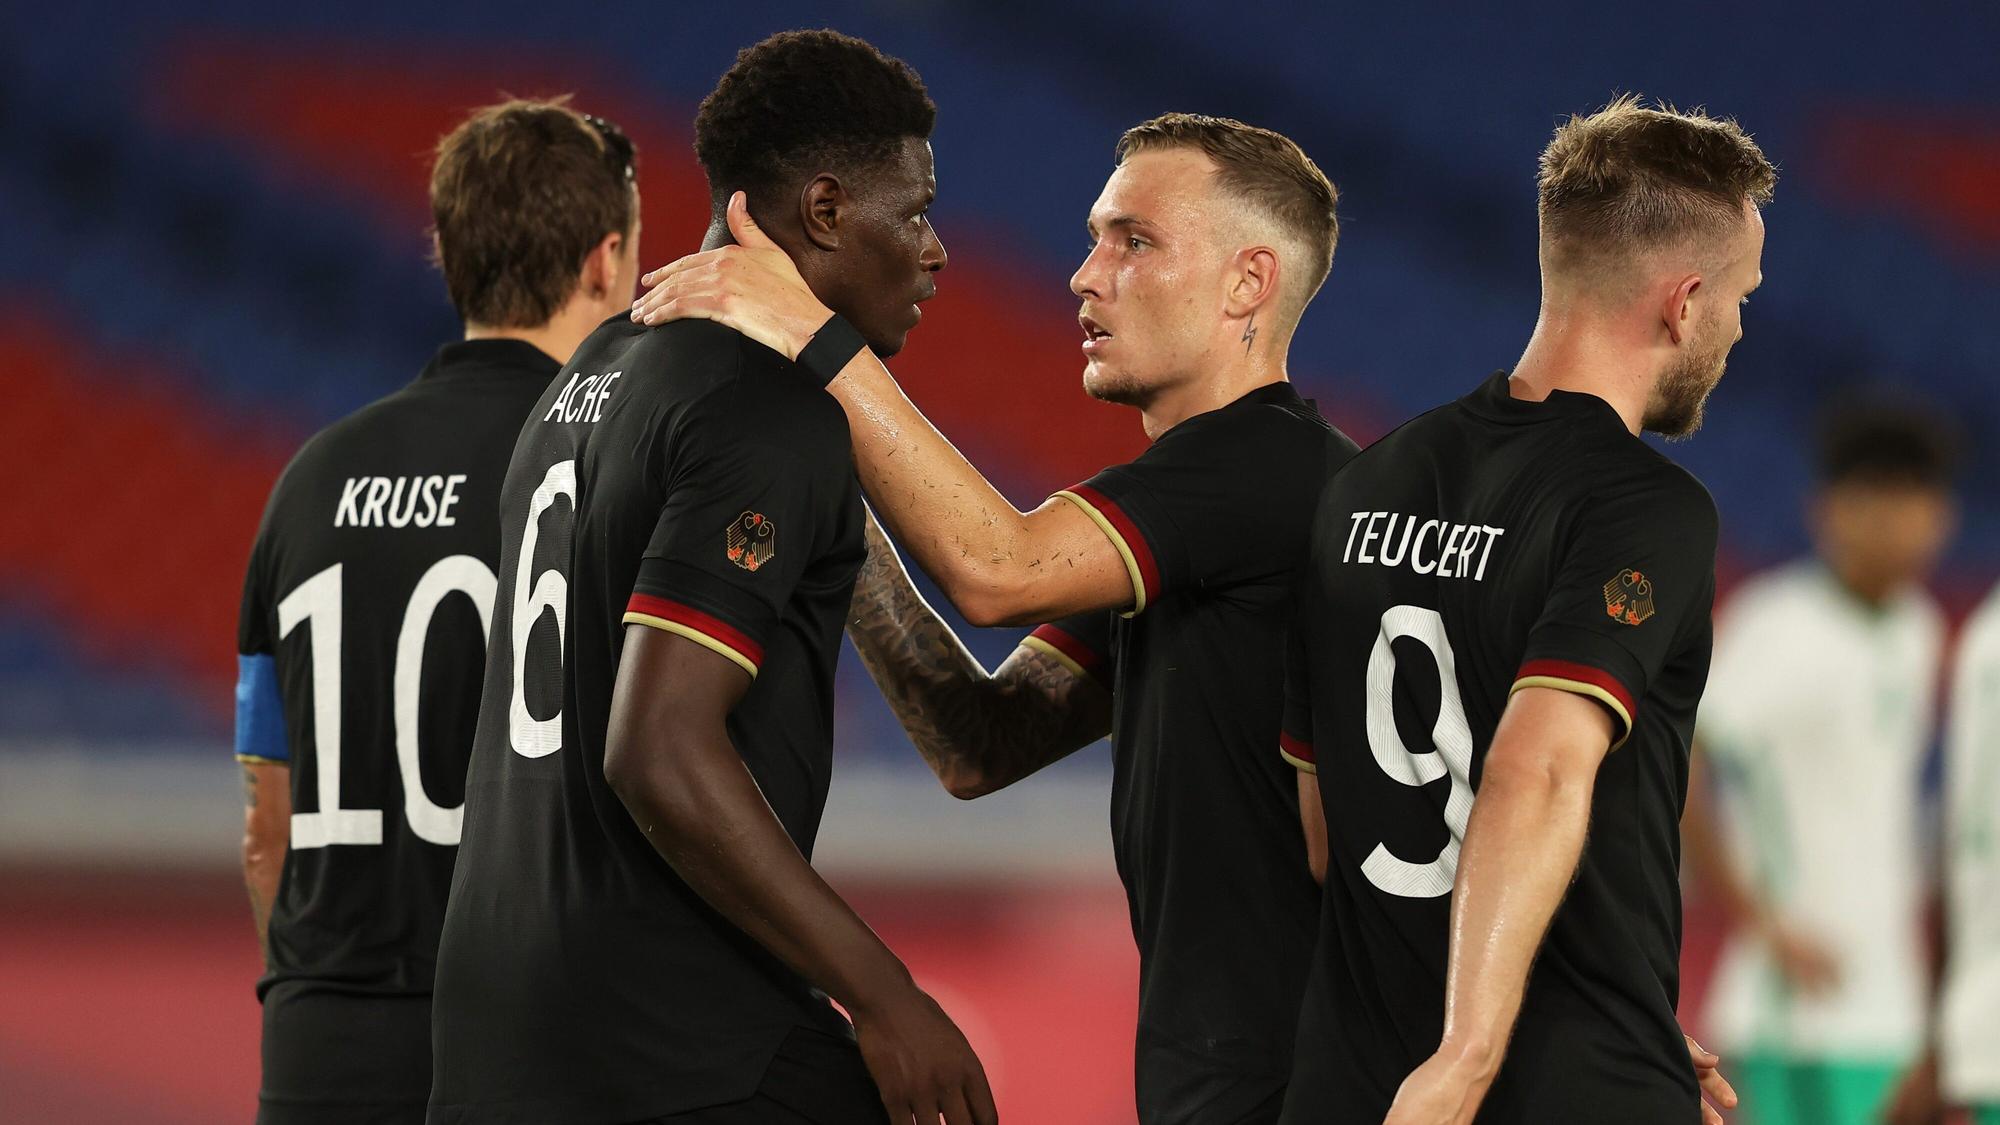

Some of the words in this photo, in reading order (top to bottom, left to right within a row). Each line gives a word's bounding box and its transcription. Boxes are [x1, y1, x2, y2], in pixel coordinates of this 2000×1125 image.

[334, 474, 467, 528] KRUSE
[543, 371, 623, 423] ACHE
[277, 554, 499, 850] 10
[508, 459, 577, 759] 6
[1360, 604, 1476, 898] 9
